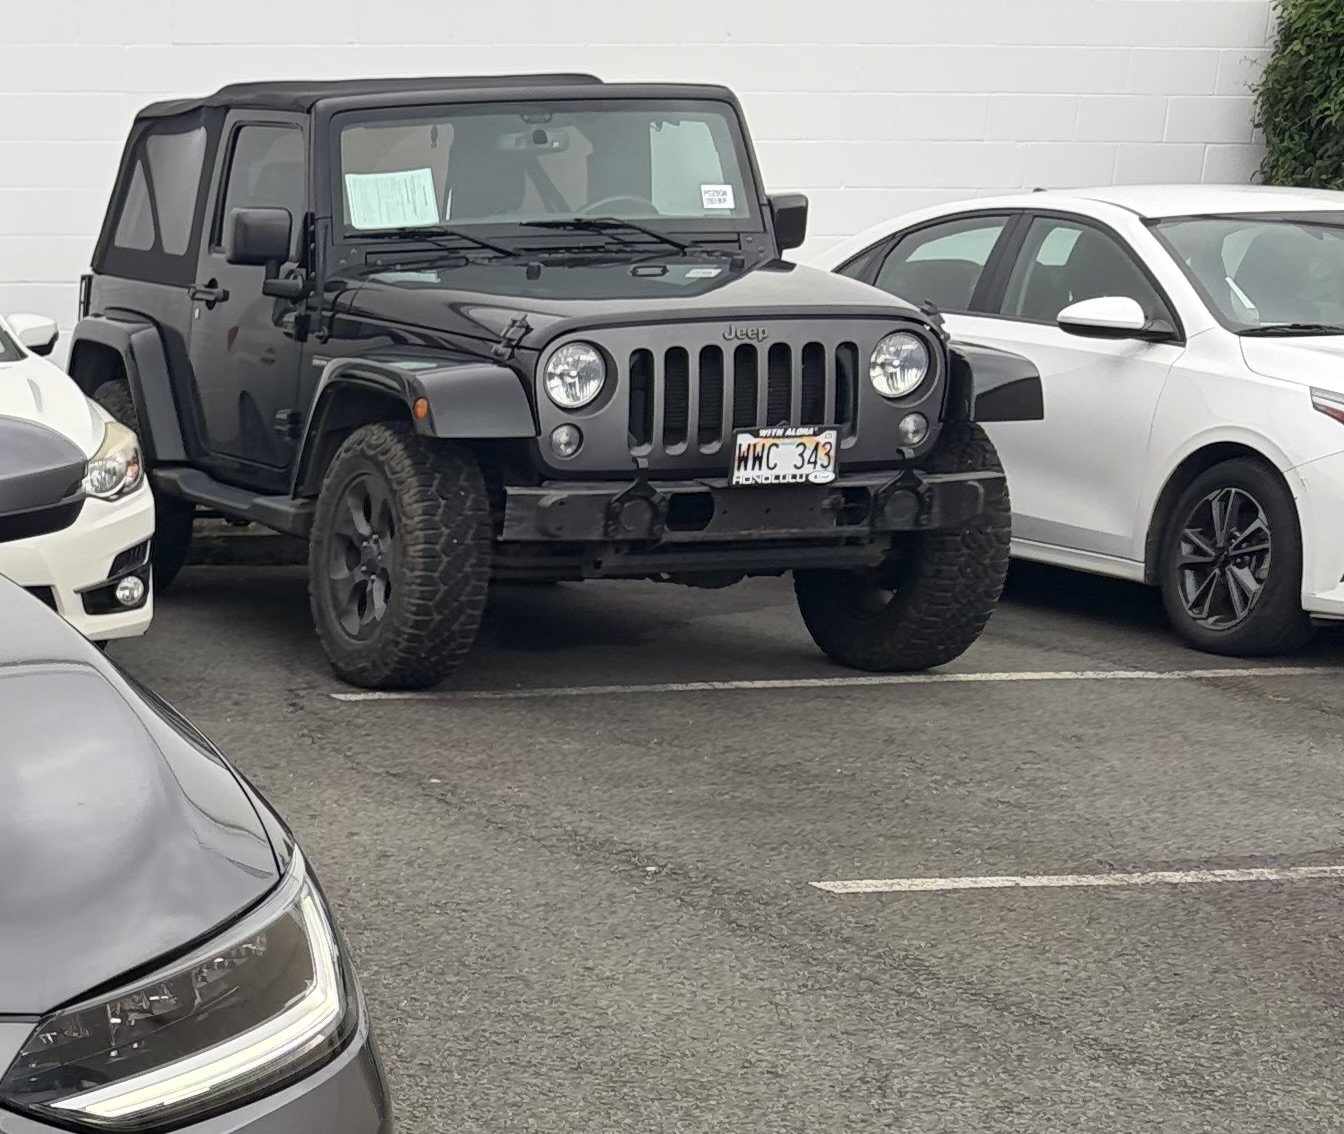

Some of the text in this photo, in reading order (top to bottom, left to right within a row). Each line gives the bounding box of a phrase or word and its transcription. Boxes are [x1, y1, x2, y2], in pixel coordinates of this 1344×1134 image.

[722, 325, 768, 342] Jeep
[736, 441, 833, 471] WWC 343
